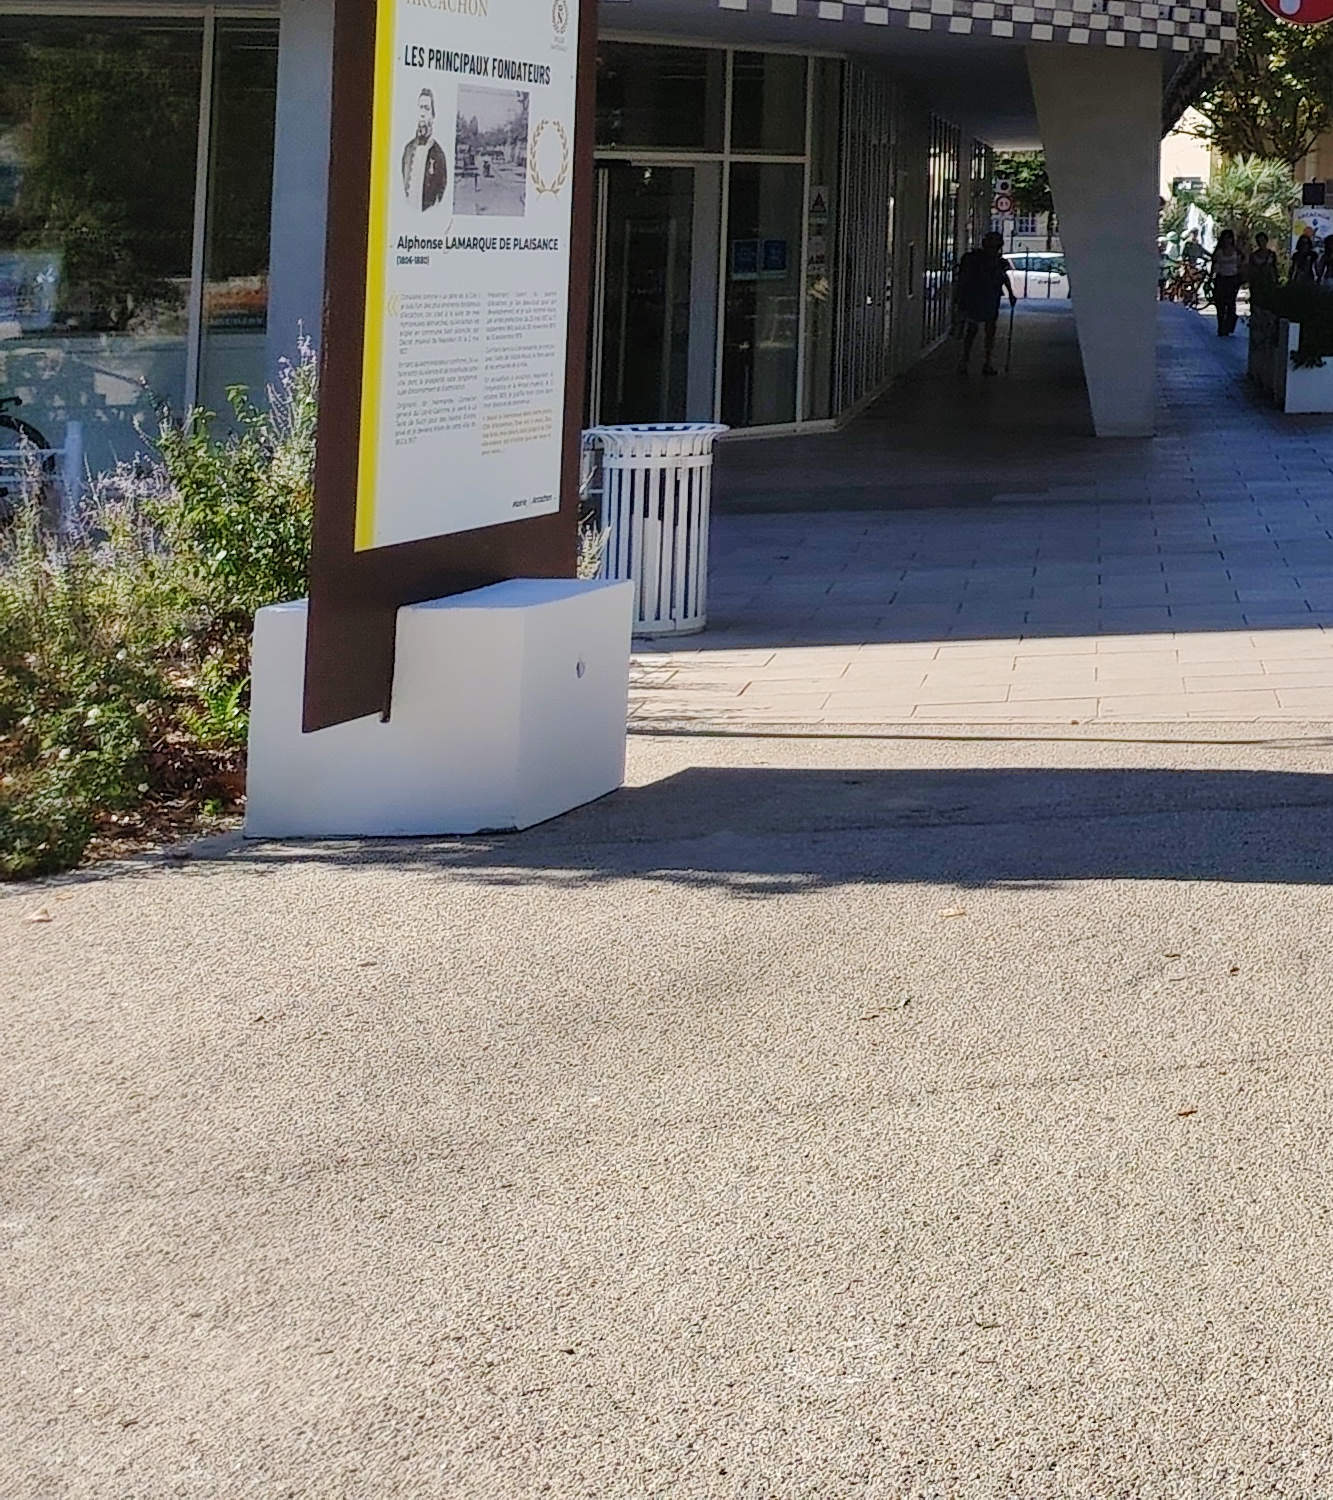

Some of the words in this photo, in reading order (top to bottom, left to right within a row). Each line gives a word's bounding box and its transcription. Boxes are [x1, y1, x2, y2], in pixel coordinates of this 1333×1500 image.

[404, 44, 424, 68] LES
[428, 49, 490, 78] PRINCIPAUX
[492, 57, 551, 86] FONDATEURS
[396, 235, 444, 252] Alphonse
[445, 237, 498, 252] LAMARQUE
[500, 238, 510, 250] DE
[513, 238, 559, 250] PLAISANCE
